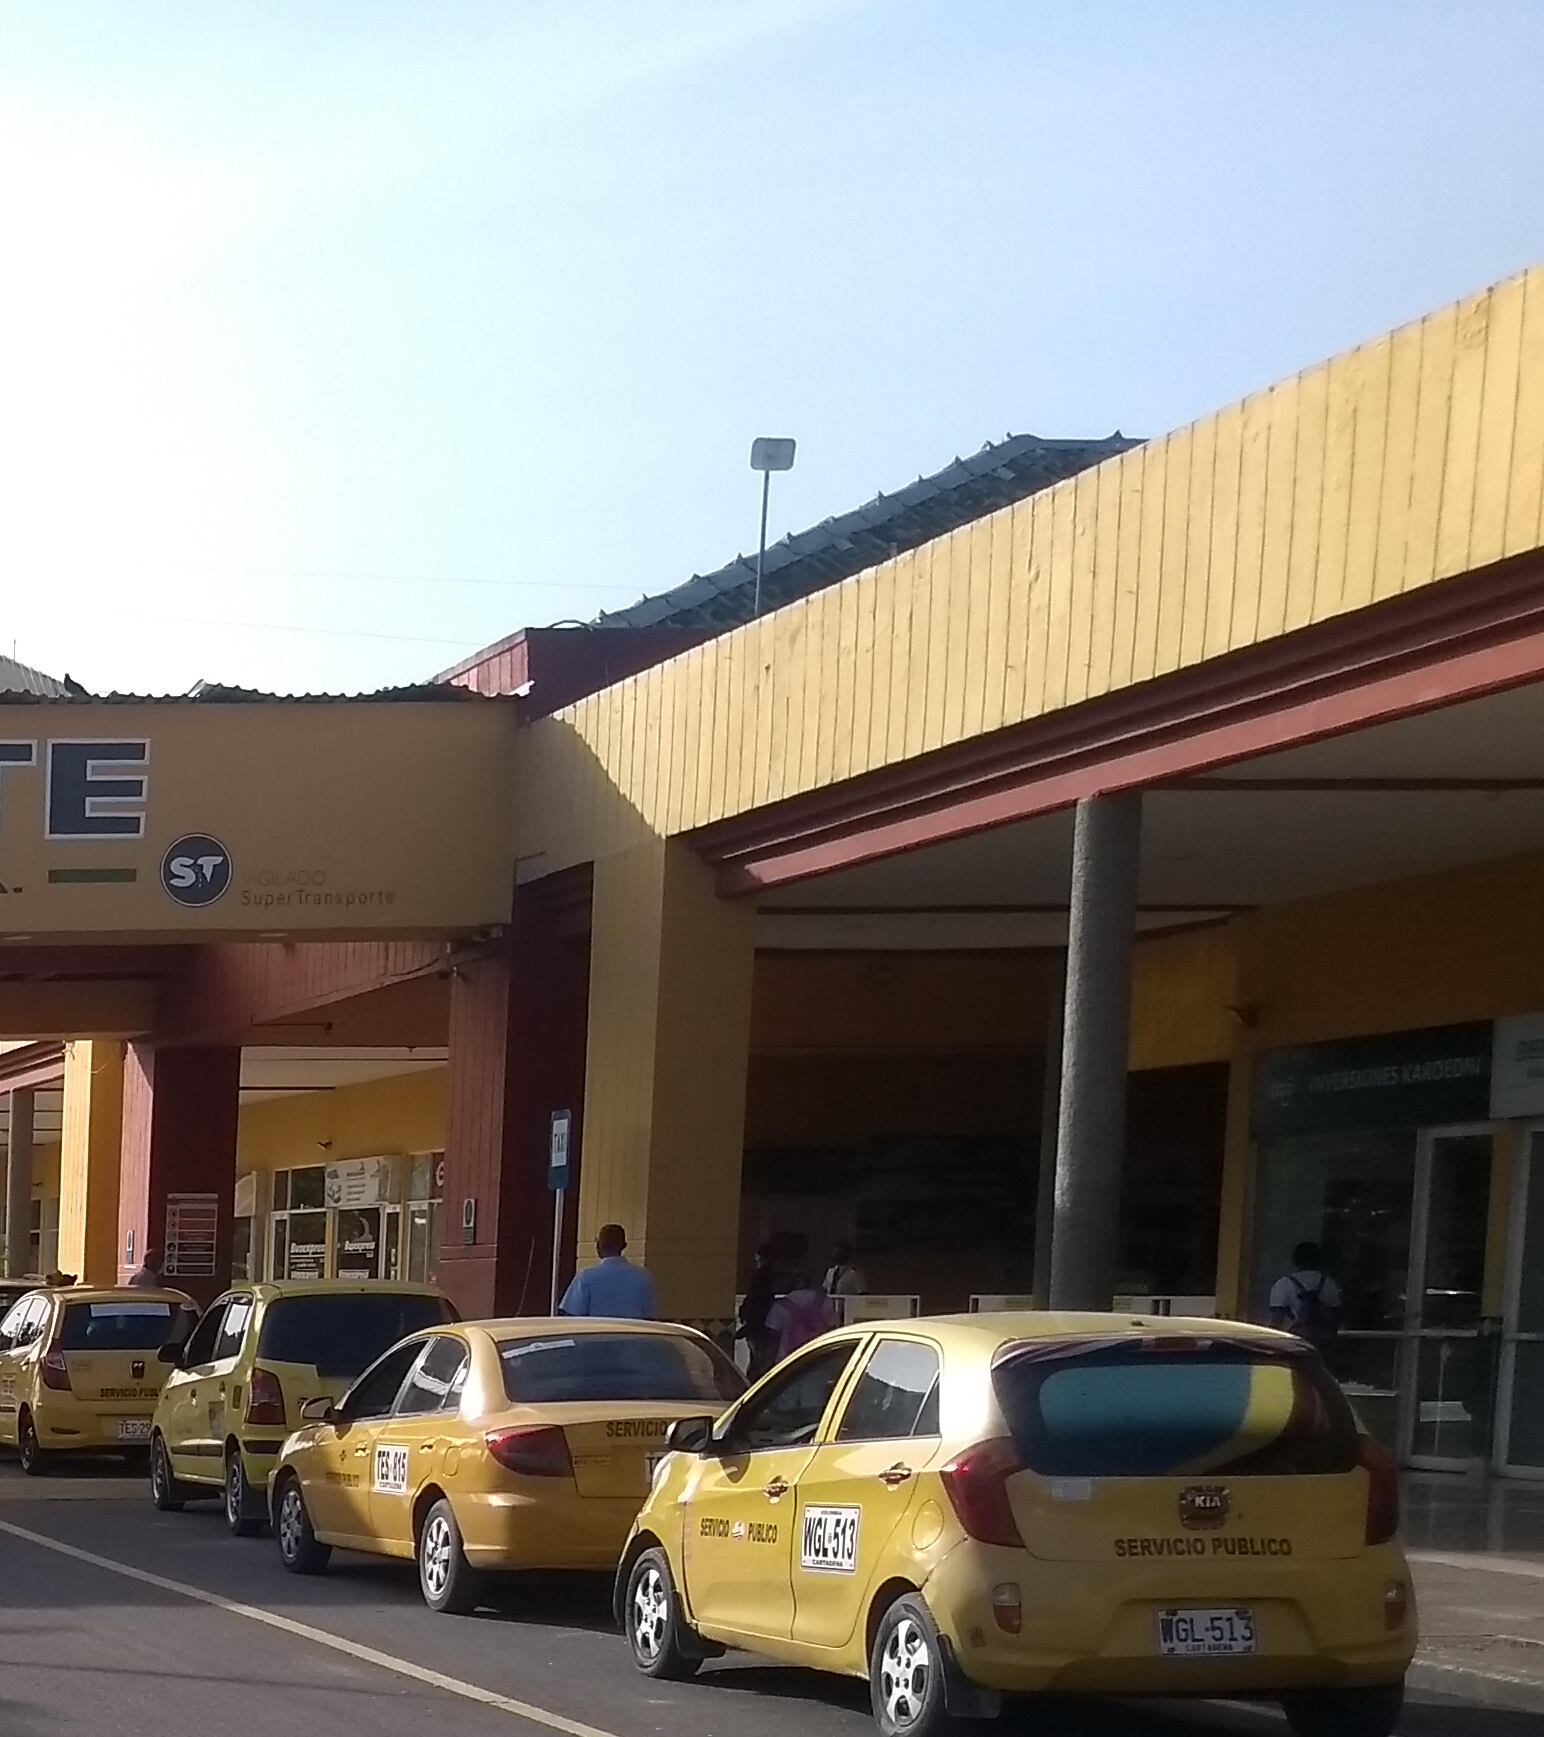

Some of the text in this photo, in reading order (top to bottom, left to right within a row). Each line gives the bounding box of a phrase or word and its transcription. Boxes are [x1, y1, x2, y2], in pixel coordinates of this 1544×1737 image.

[242, 868, 327, 887] VIGILADO
[606, 1420, 668, 1438] SERVICIO
[1194, 1495, 1221, 1508] KIA
[699, 1517, 779, 1544] SERVICIO PUBLICO
[1114, 1537, 1293, 1558] SERVICIO PUBLICO
